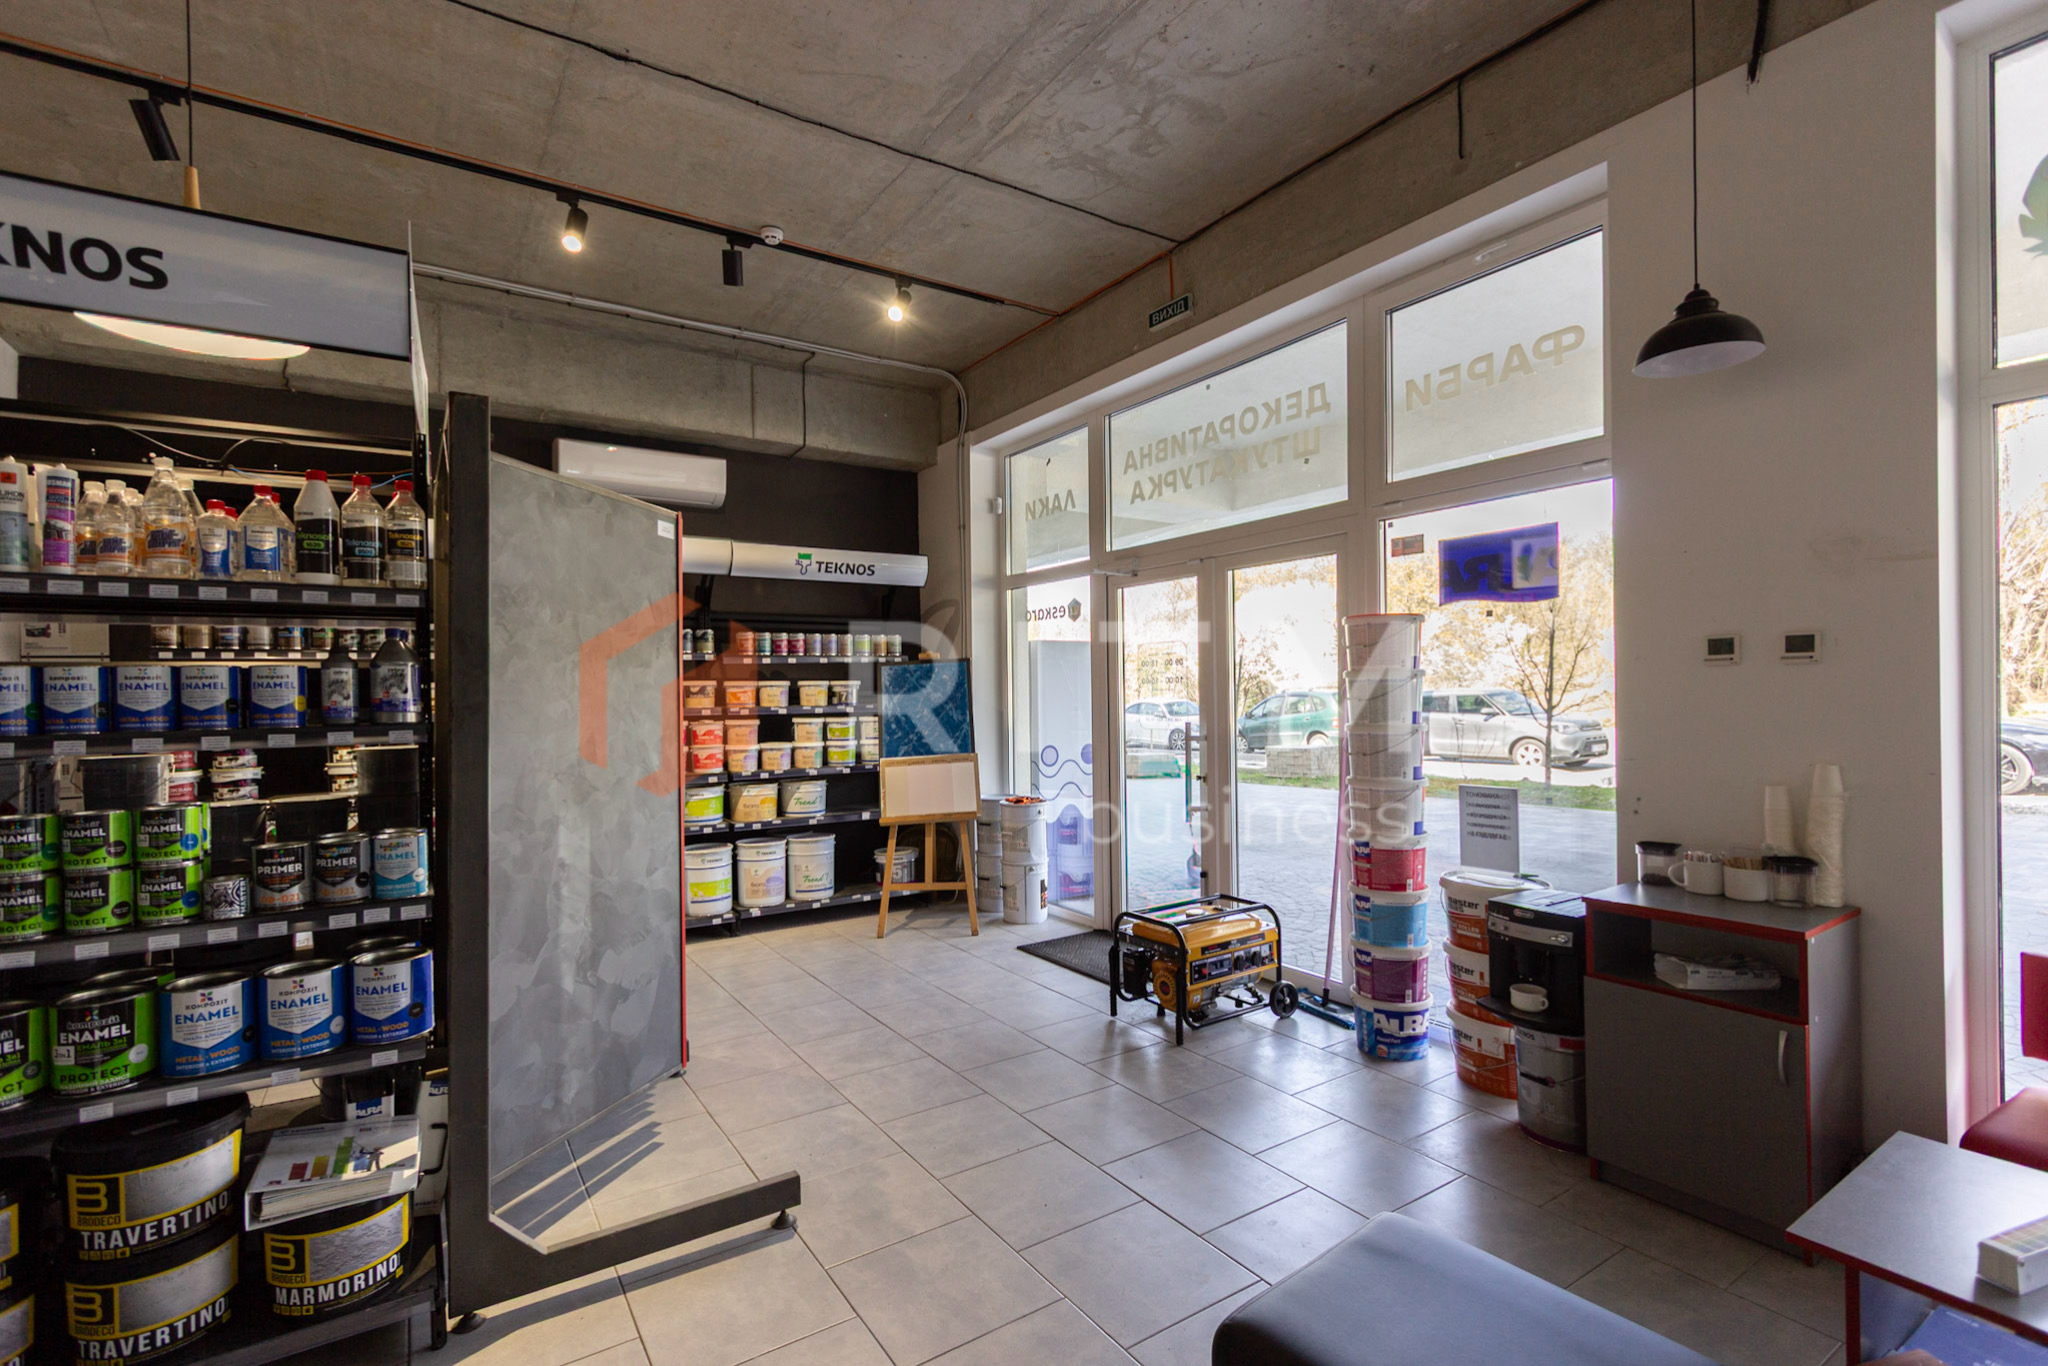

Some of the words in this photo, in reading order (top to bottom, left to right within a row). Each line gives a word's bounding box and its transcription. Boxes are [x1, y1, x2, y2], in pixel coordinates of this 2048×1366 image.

[0, 221, 169, 290] NOS
[1152, 299, 1186, 326] ВИХІД
[815, 560, 876, 577] TEKNOS
[44, 683, 96, 692] ENAMEL
[119, 682, 169, 691] ENAMEL
[181, 682, 227, 690] ENAMEL
[252, 681, 296, 690] ENAMEL
[63, 828, 106, 838] ENAMEL
[140, 823, 184, 834] ENAMEL
[317, 856, 358, 868] PRIMER
[257, 863, 303, 875] PRIMER
[141, 881, 184, 892] ENAMEL
[355, 982, 408, 996] ENAMEL
[270, 992, 329, 1010] ENAMEL
[174, 1005, 240, 1025] ENAMEL
[382, 1020, 409, 1032] WOOD
[60, 1023, 131, 1045] ENAMEL
[301, 1031, 330, 1044] WOOD
[175, 1054, 204, 1064] METAL
[210, 1045, 241, 1058] WOOD
[60, 1064, 130, 1083] PROTECT
[77, 1215, 121, 1227] BRODECO
[81, 1190, 229, 1250] TRAVERTINO
[271, 1273, 306, 1285] BRODECO
[275, 1253, 399, 1306] MARMORINO
[73, 1325, 115, 1337] BRODECO
[77, 1297, 227, 1360] TRAVERTINO
